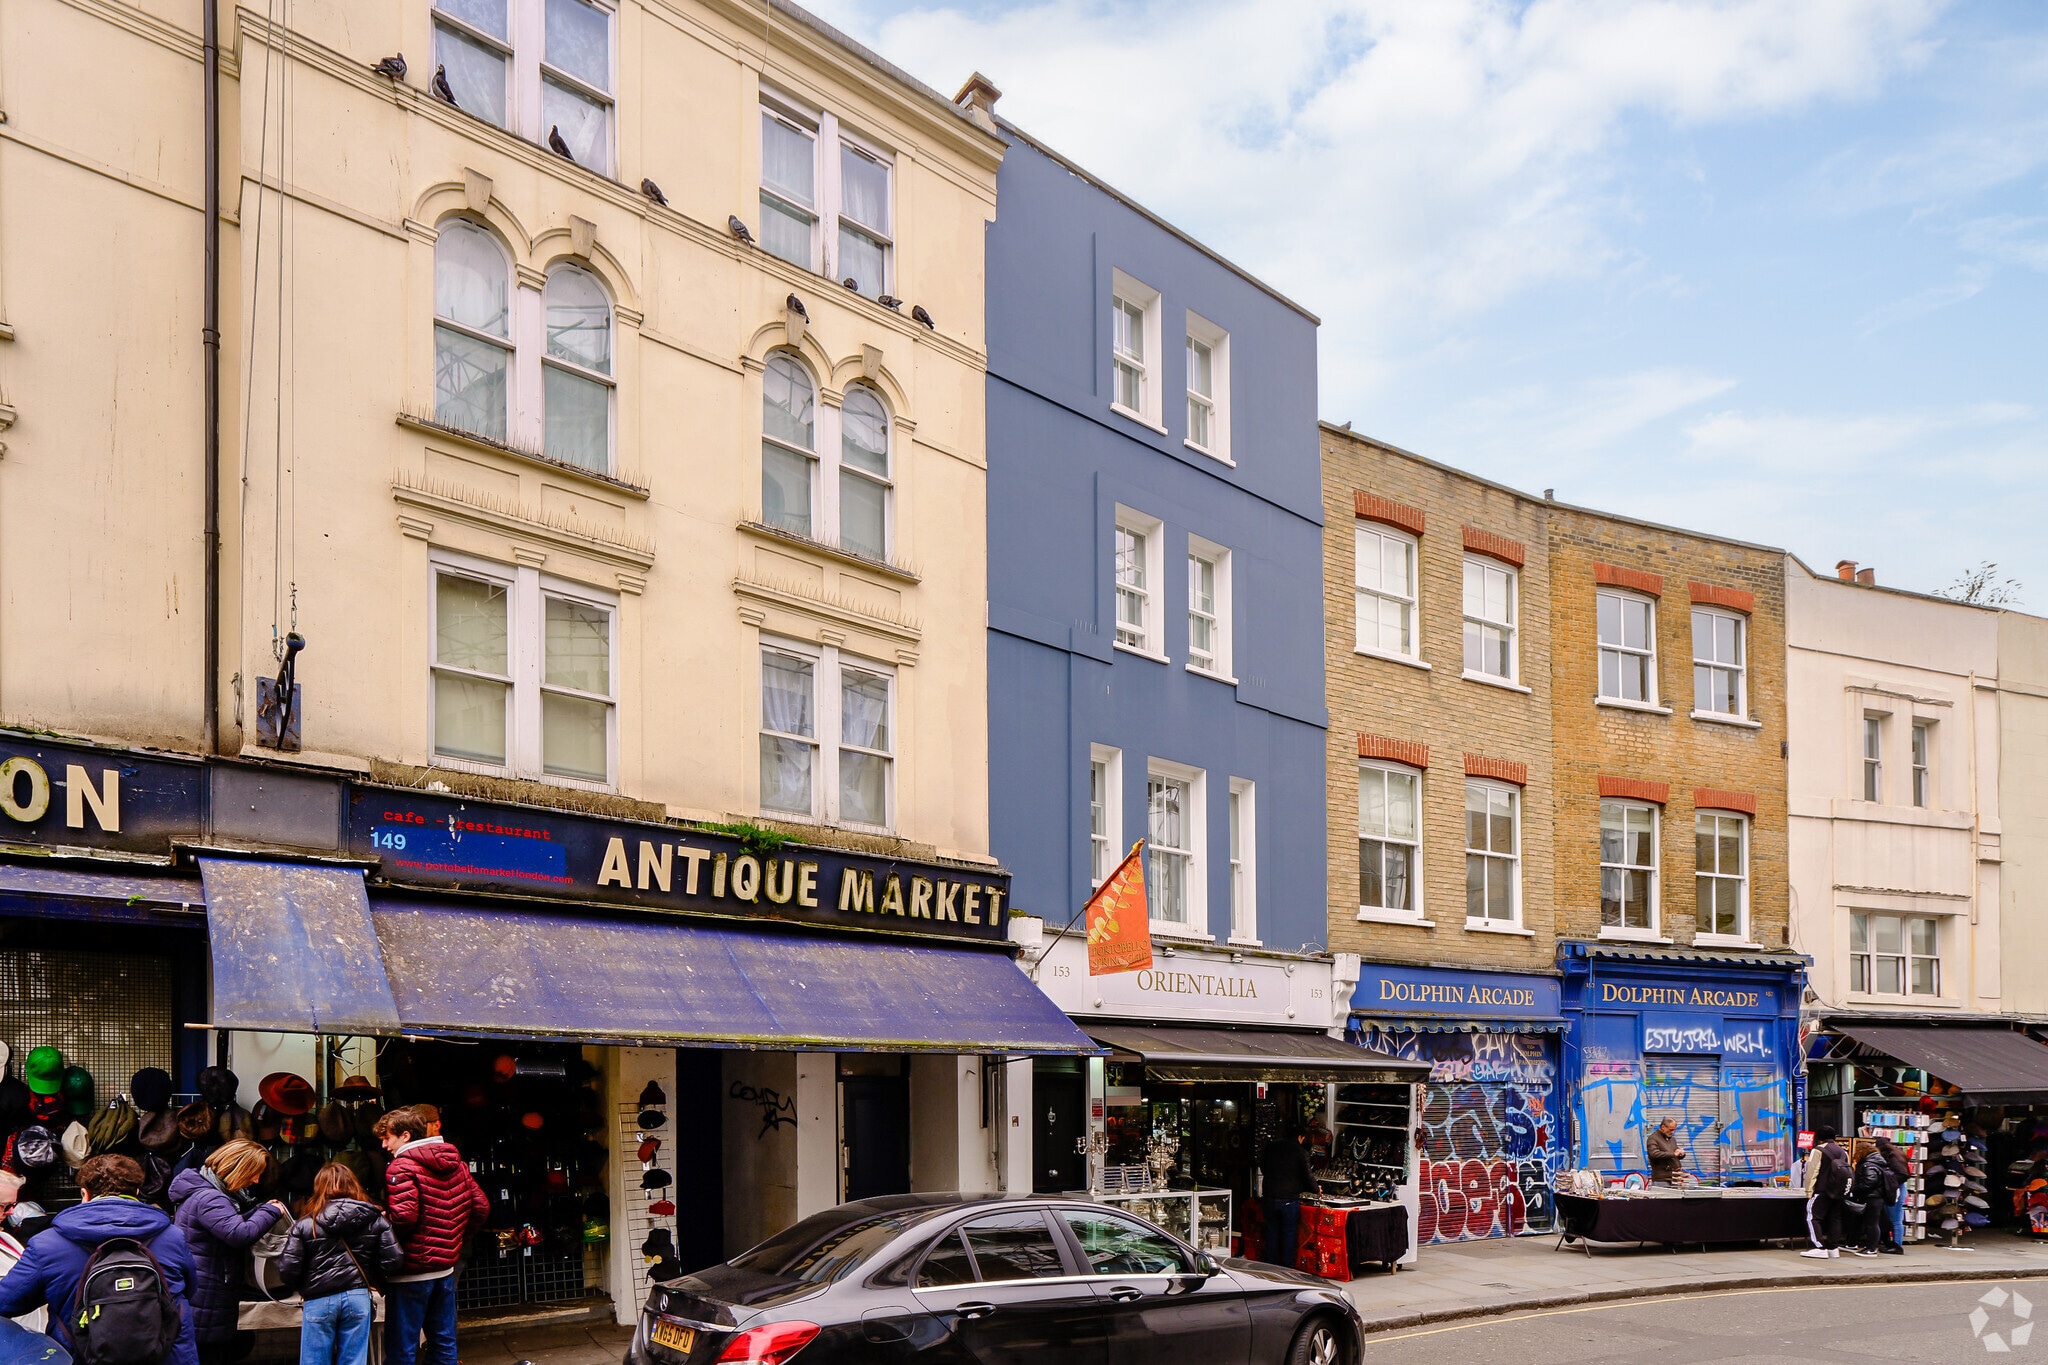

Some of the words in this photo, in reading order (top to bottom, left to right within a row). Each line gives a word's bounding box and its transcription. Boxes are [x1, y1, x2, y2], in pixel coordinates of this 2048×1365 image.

[383, 811, 425, 825] cafe
[455, 820, 551, 841] restaurant
[370, 832, 407, 850] 149
[597, 837, 818, 908] ANTIQUE
[838, 866, 1006, 927] MARKET
[1092, 939, 1149, 957] PORTOBELLO
[1053, 965, 1070, 978] 153
[1137, 969, 1258, 999] ORIENTALIA
[1310, 988, 1323, 999] 153
[1379, 980, 1464, 1002] DOLPHIN
[1467, 984, 1535, 1006] ARCADE
[1602, 983, 1685, 1005] DOLPHIN
[1689, 987, 1759, 1007] ARCADE
